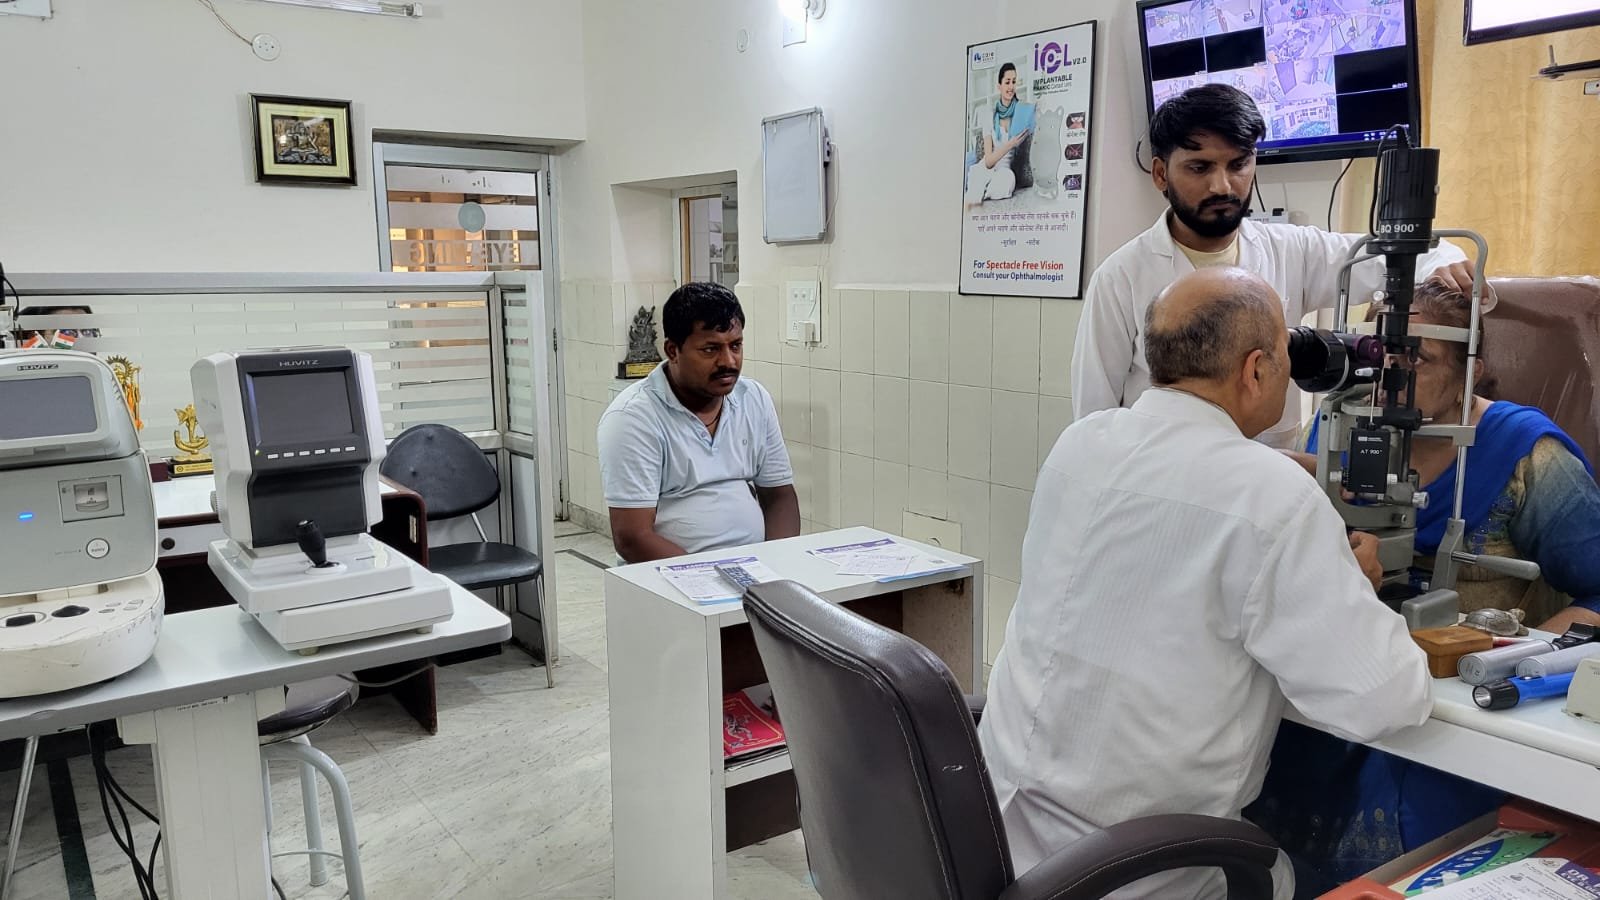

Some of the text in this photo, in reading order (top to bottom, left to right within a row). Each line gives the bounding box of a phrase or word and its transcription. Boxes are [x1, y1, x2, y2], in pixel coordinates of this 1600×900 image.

[1394, 224, 1414, 232] 900
[974, 260, 1064, 270] For Spectacle Free Vision
[996, 272, 1009, 280] your
[1010, 272, 1064, 282] Ophthalmologist
